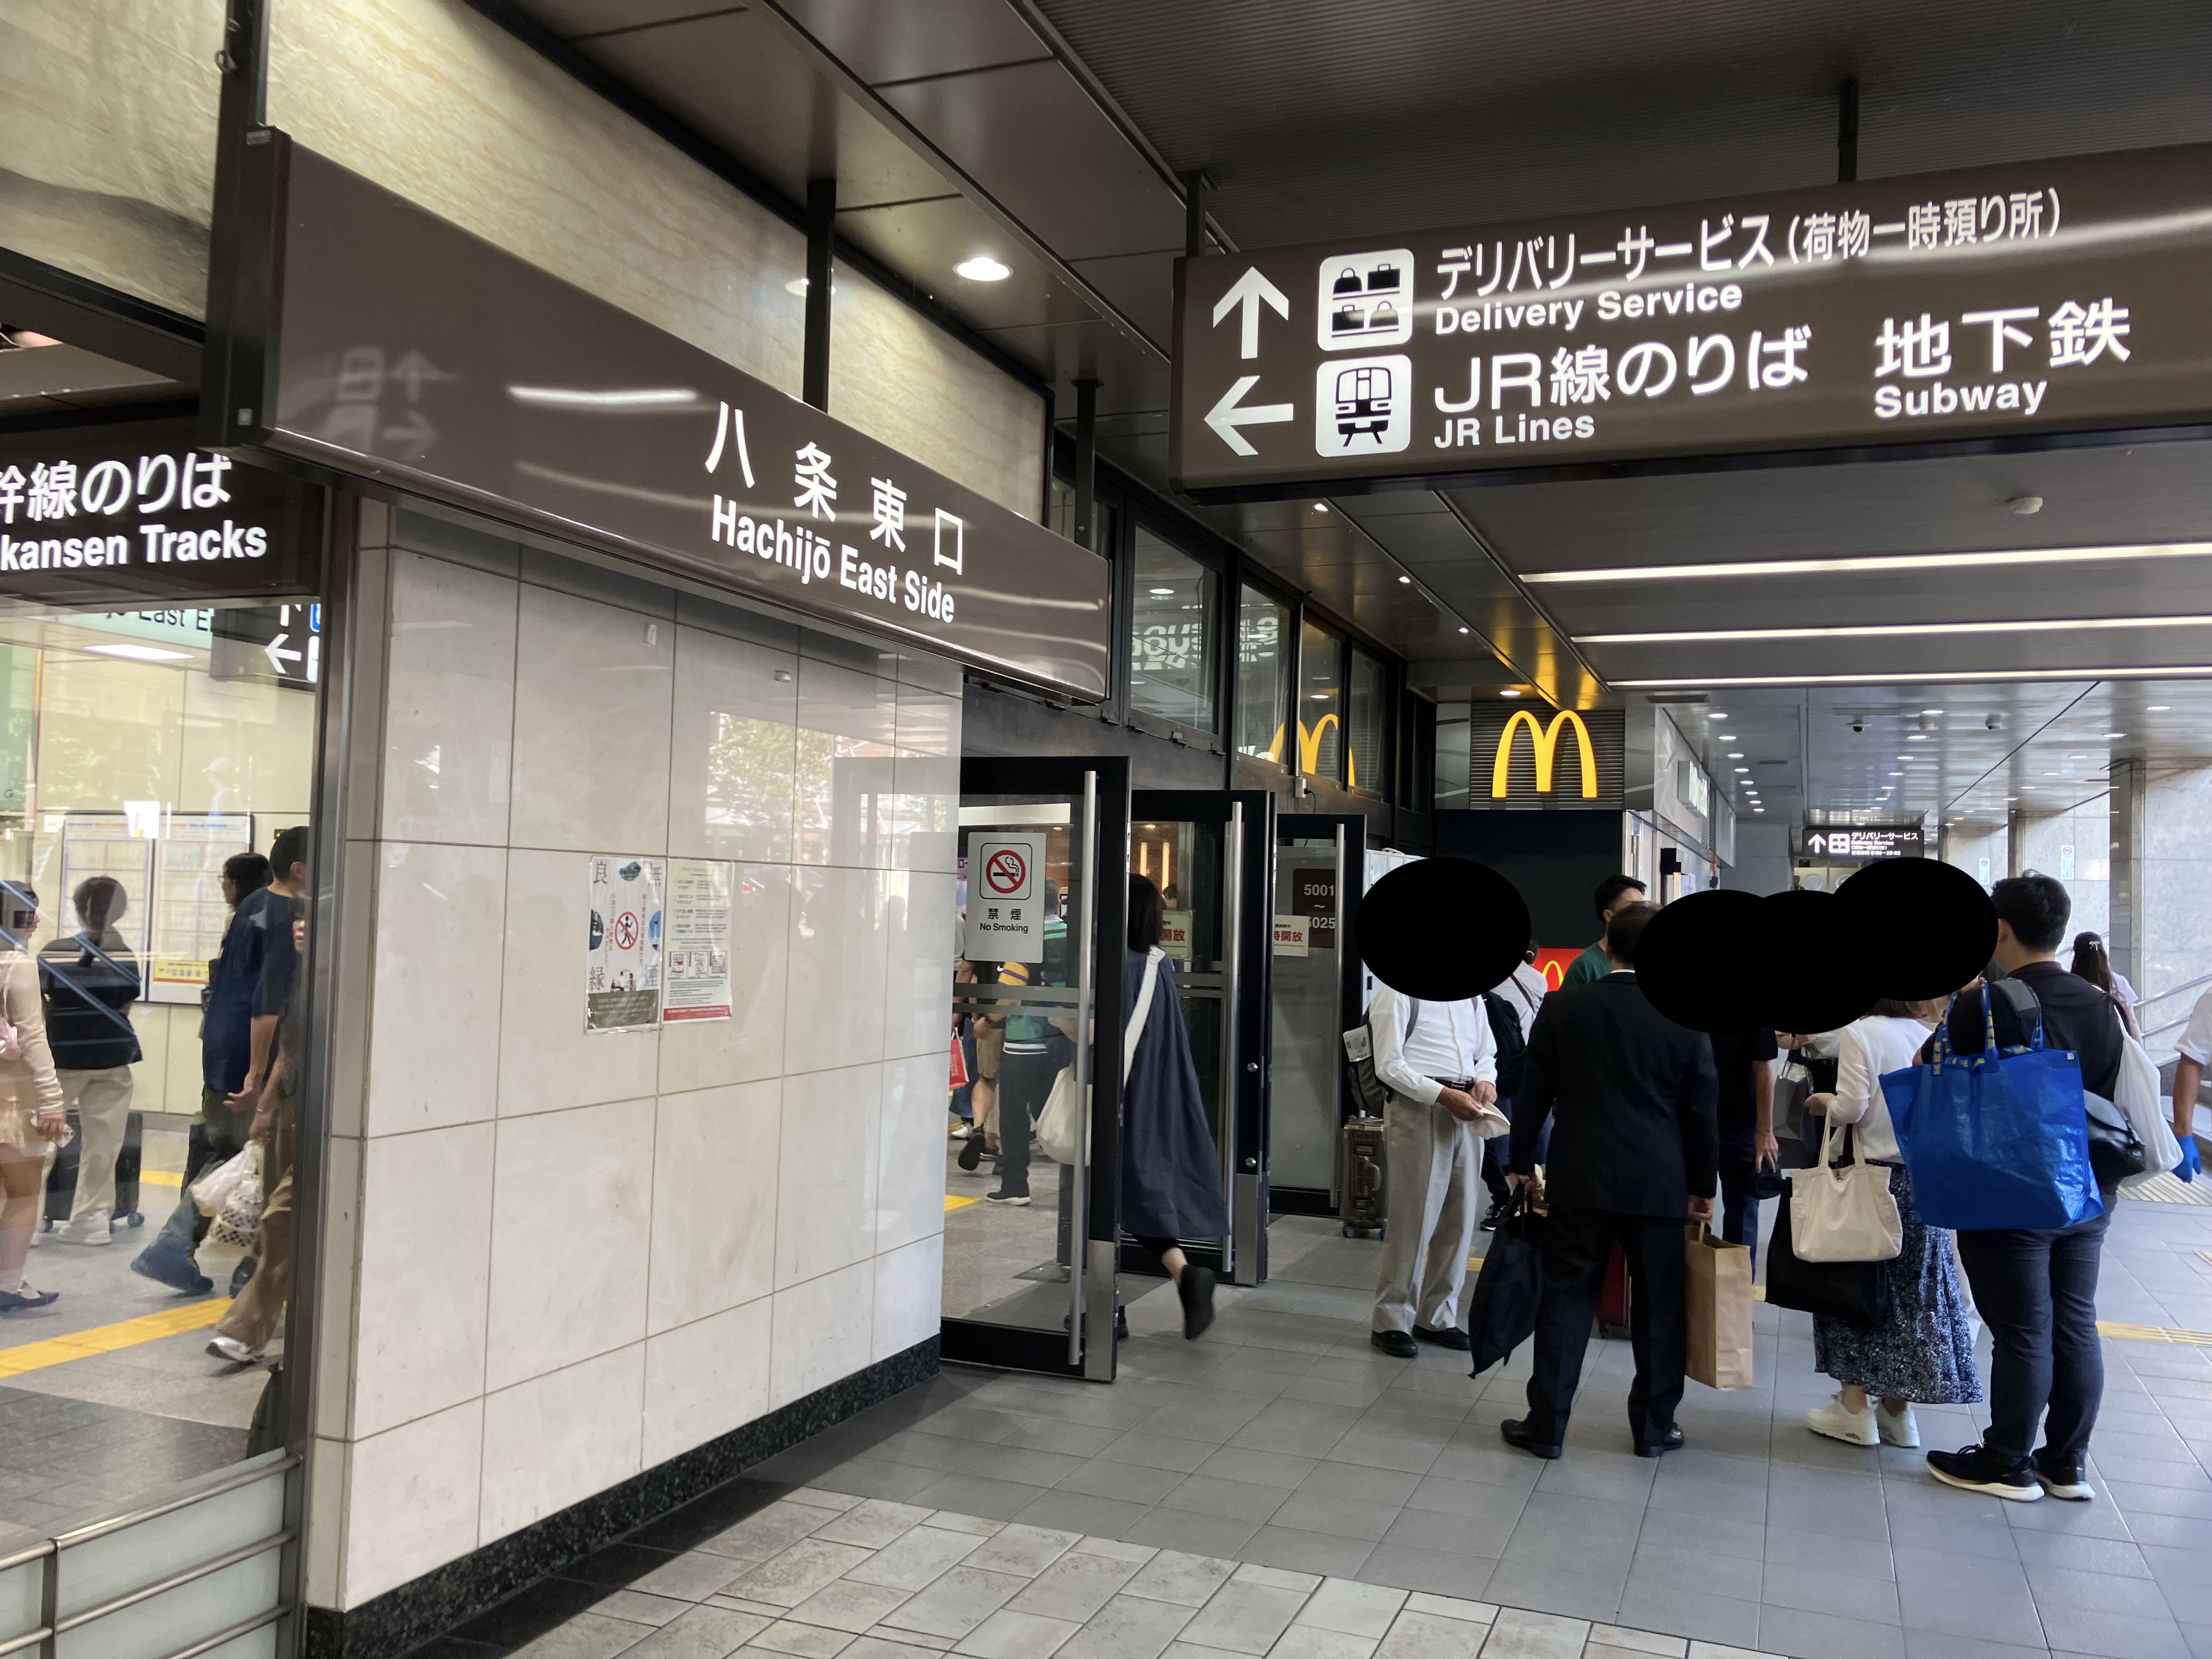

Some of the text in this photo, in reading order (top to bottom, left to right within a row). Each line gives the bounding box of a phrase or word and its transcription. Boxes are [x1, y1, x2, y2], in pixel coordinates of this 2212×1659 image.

[1435, 283, 1743, 335] Delivery Service
[1874, 297, 2131, 379] 地下鉄
[1434, 324, 1813, 413] JR線のりば
[1874, 380, 2047, 419] Subway
[1434, 413, 1595, 448] JR Lines
[704, 400, 964, 576] 八条東口
[0, 518, 268, 571] kansen Tracks
[712, 494, 955, 623] Hachijō East Side
[1851, 832, 1918, 840] デリバリーサービス
[1304, 884, 1334, 896] 5001
[988, 908, 1022, 920] 禁煙
[993, 923, 1028, 934] Smoking
